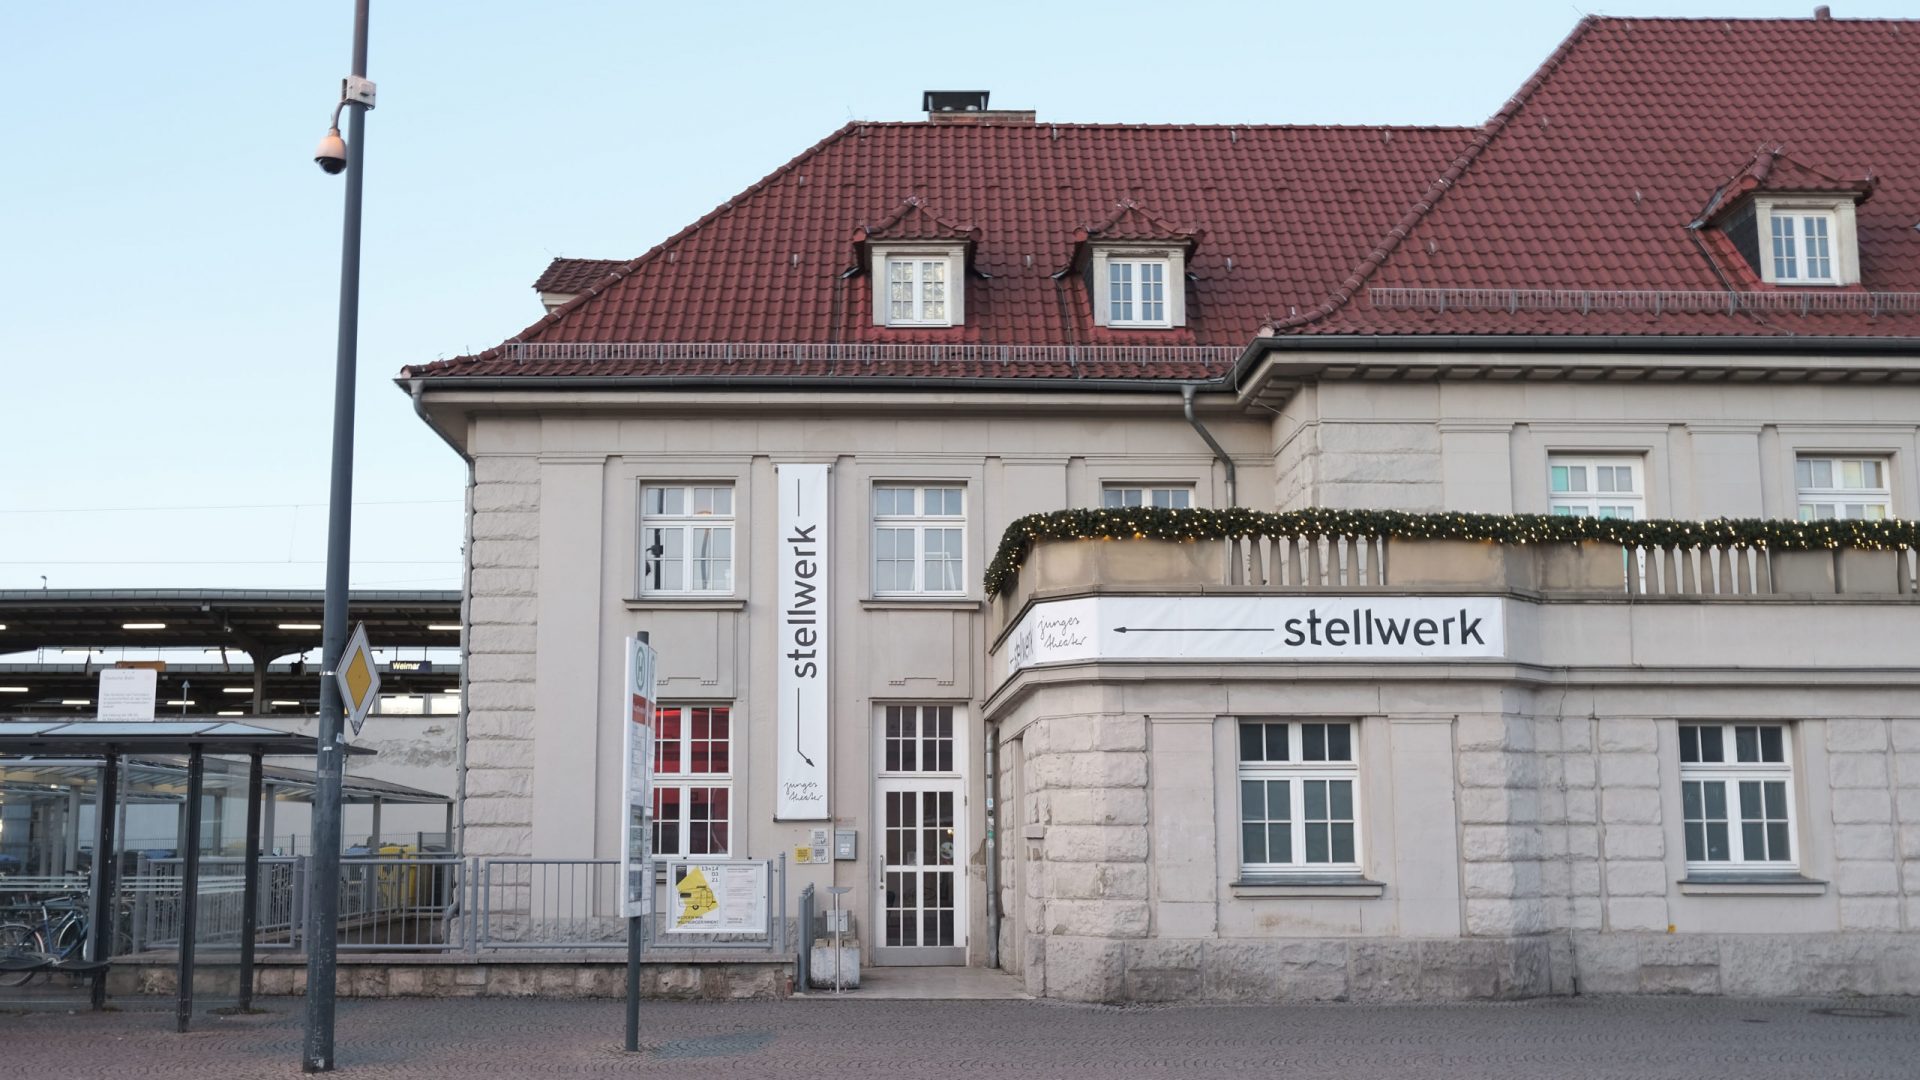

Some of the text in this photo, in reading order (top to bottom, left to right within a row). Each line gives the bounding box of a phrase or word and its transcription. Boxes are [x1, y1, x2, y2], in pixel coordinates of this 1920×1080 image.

[787, 524, 817, 679] stellwerk
[1038, 616, 1080, 640] junges
[1284, 608, 1486, 646] stellwerk
[1044, 633, 1087, 651] theater
[392, 662, 421, 670] Weimar
[783, 779, 818, 795] junges
[789, 791, 824, 803] theater
